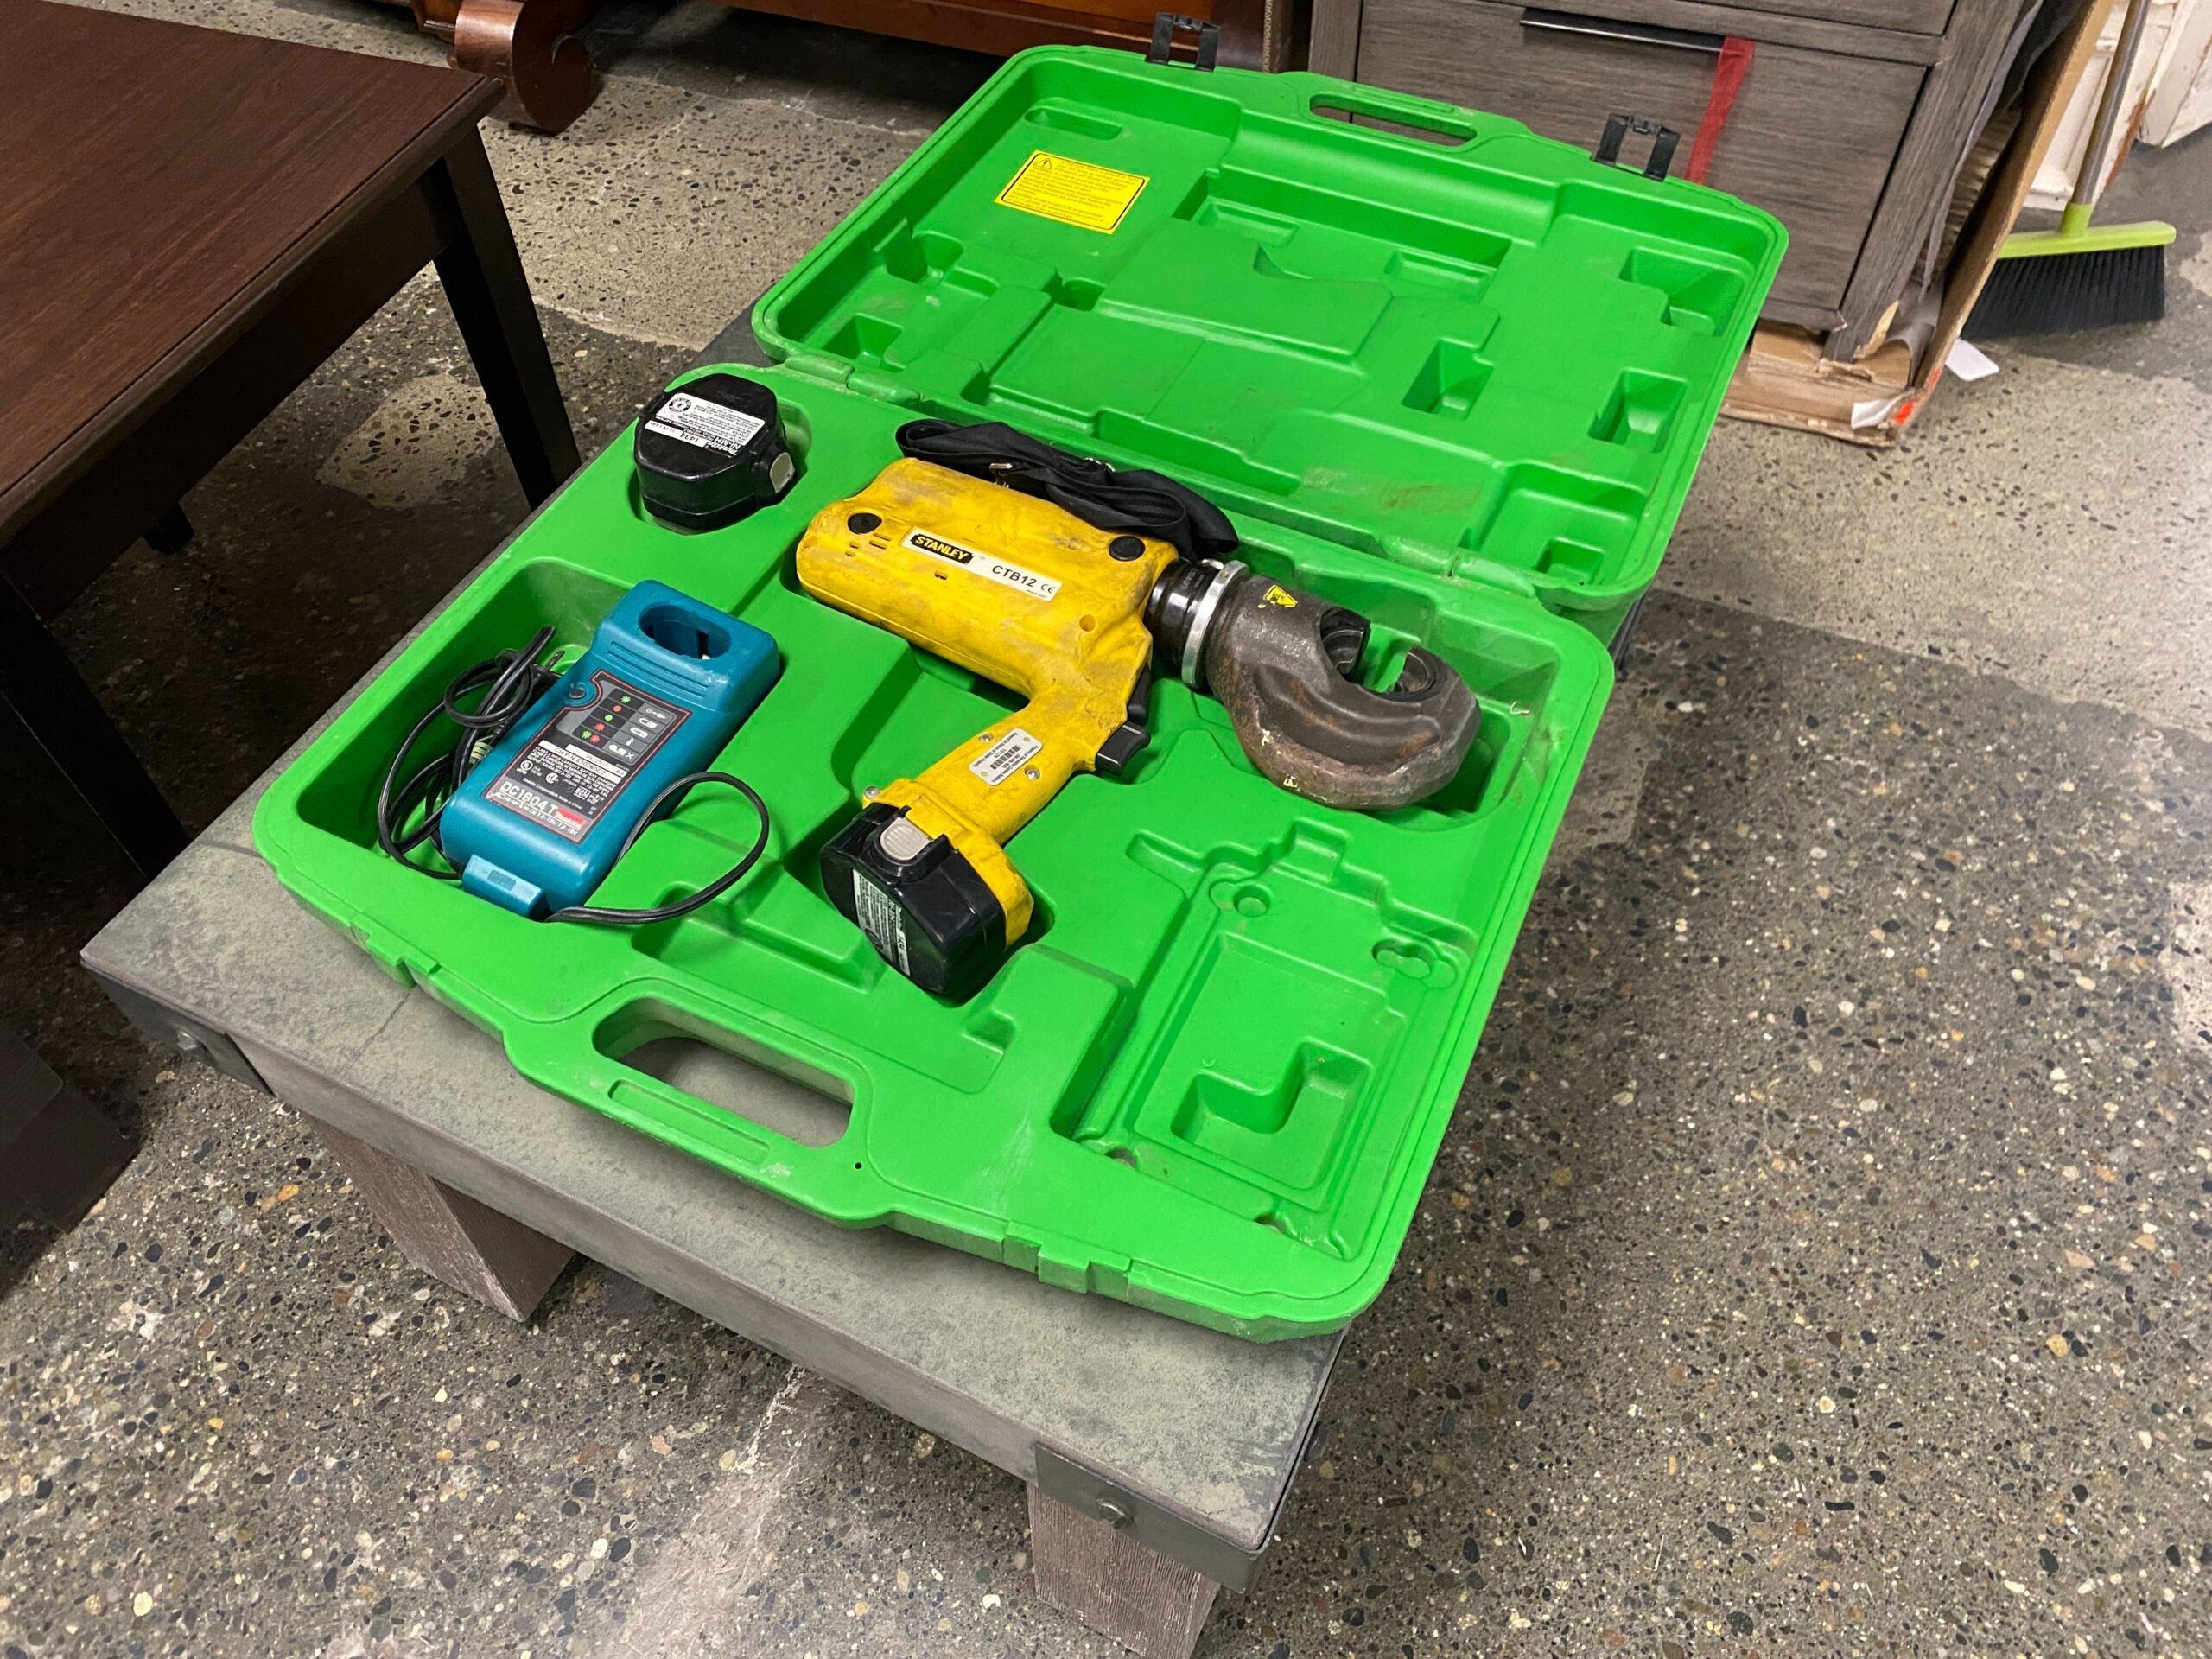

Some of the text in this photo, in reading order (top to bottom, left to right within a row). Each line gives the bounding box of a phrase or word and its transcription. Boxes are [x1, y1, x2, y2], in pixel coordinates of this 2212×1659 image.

[678, 432, 700, 442] 1434
[915, 536, 969, 561] STANLEY
[992, 565, 1037, 588] CTB12
